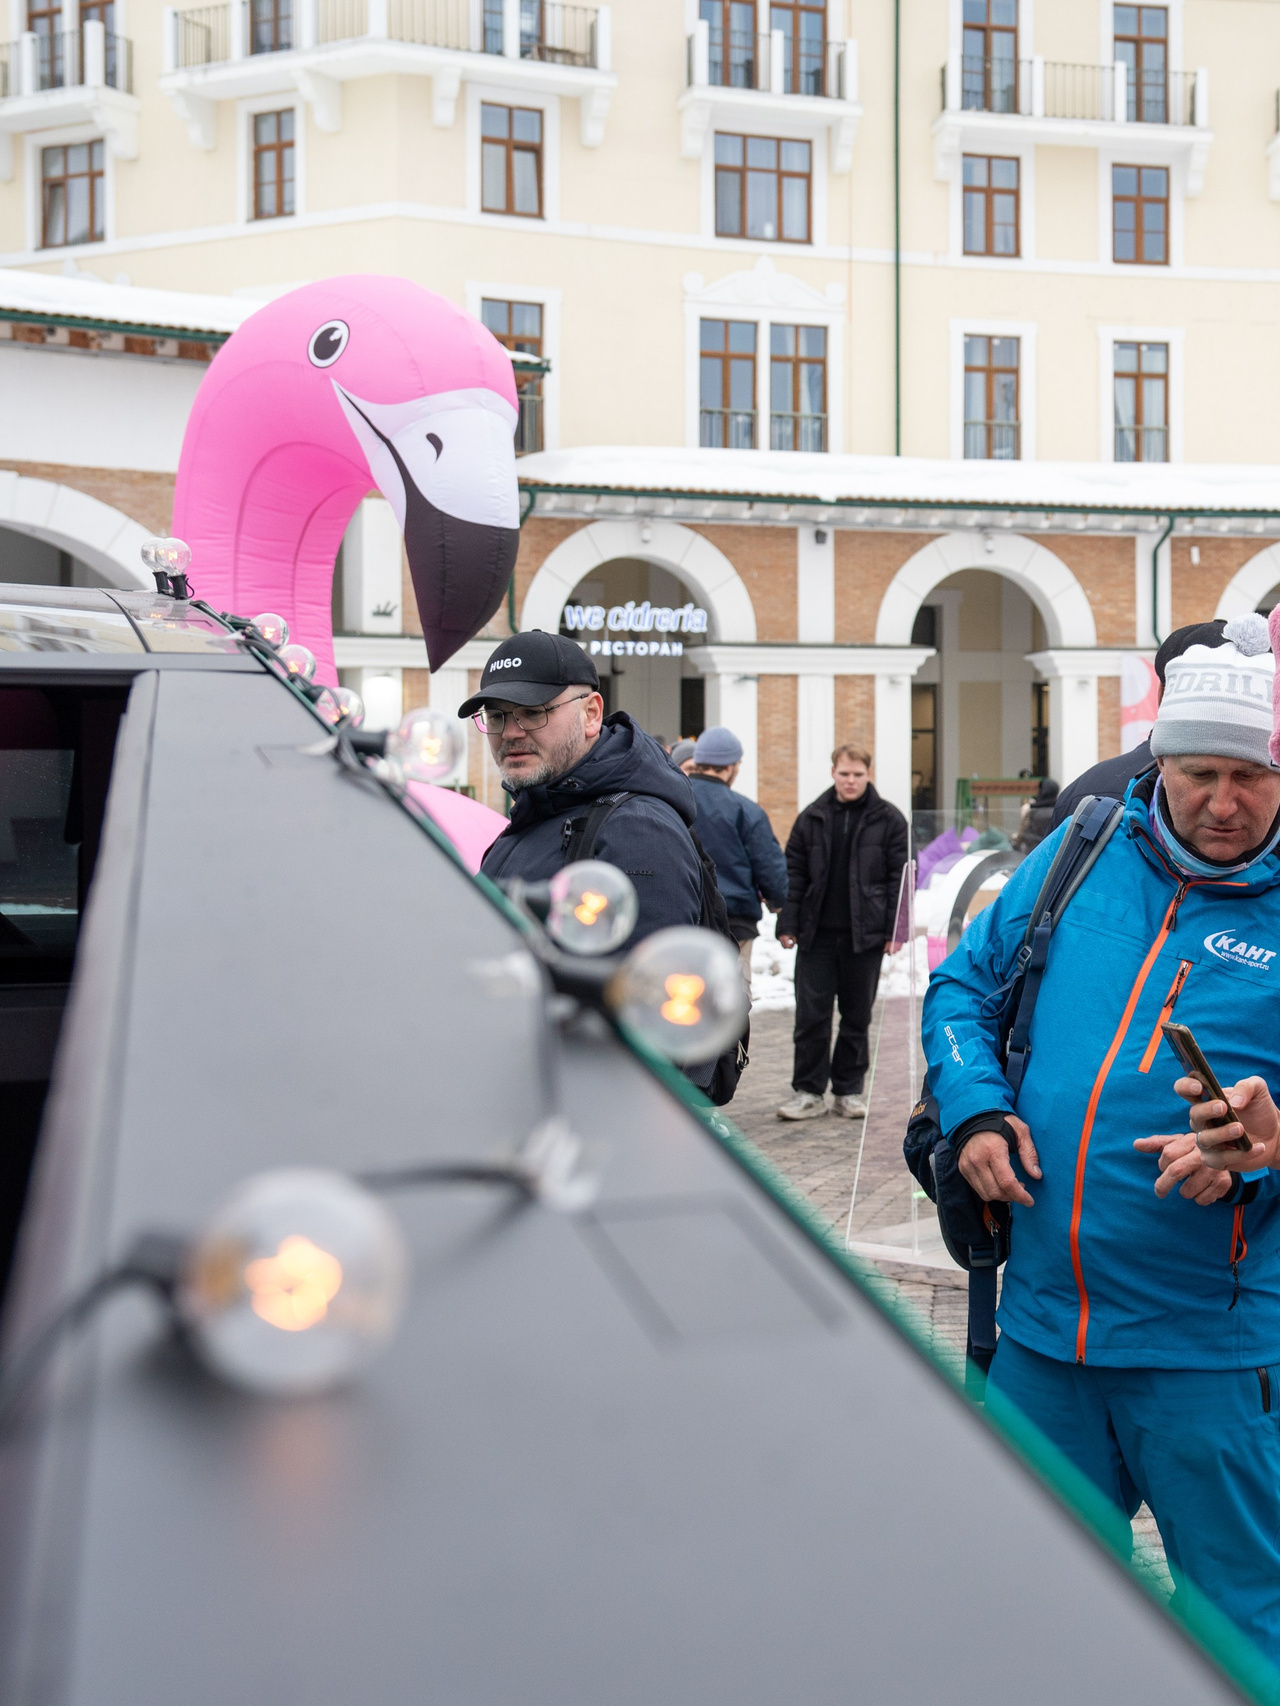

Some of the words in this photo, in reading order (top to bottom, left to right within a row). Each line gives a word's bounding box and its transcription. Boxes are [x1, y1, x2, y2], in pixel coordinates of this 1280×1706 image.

[607, 600, 708, 633] cidreria
[590, 640, 684, 656] РЕСТОРАН
[489, 657, 523, 673] HUGO
[1215, 935, 1277, 963] КАНТ
[1221, 951, 1269, 971] www.kant-sport.ru
